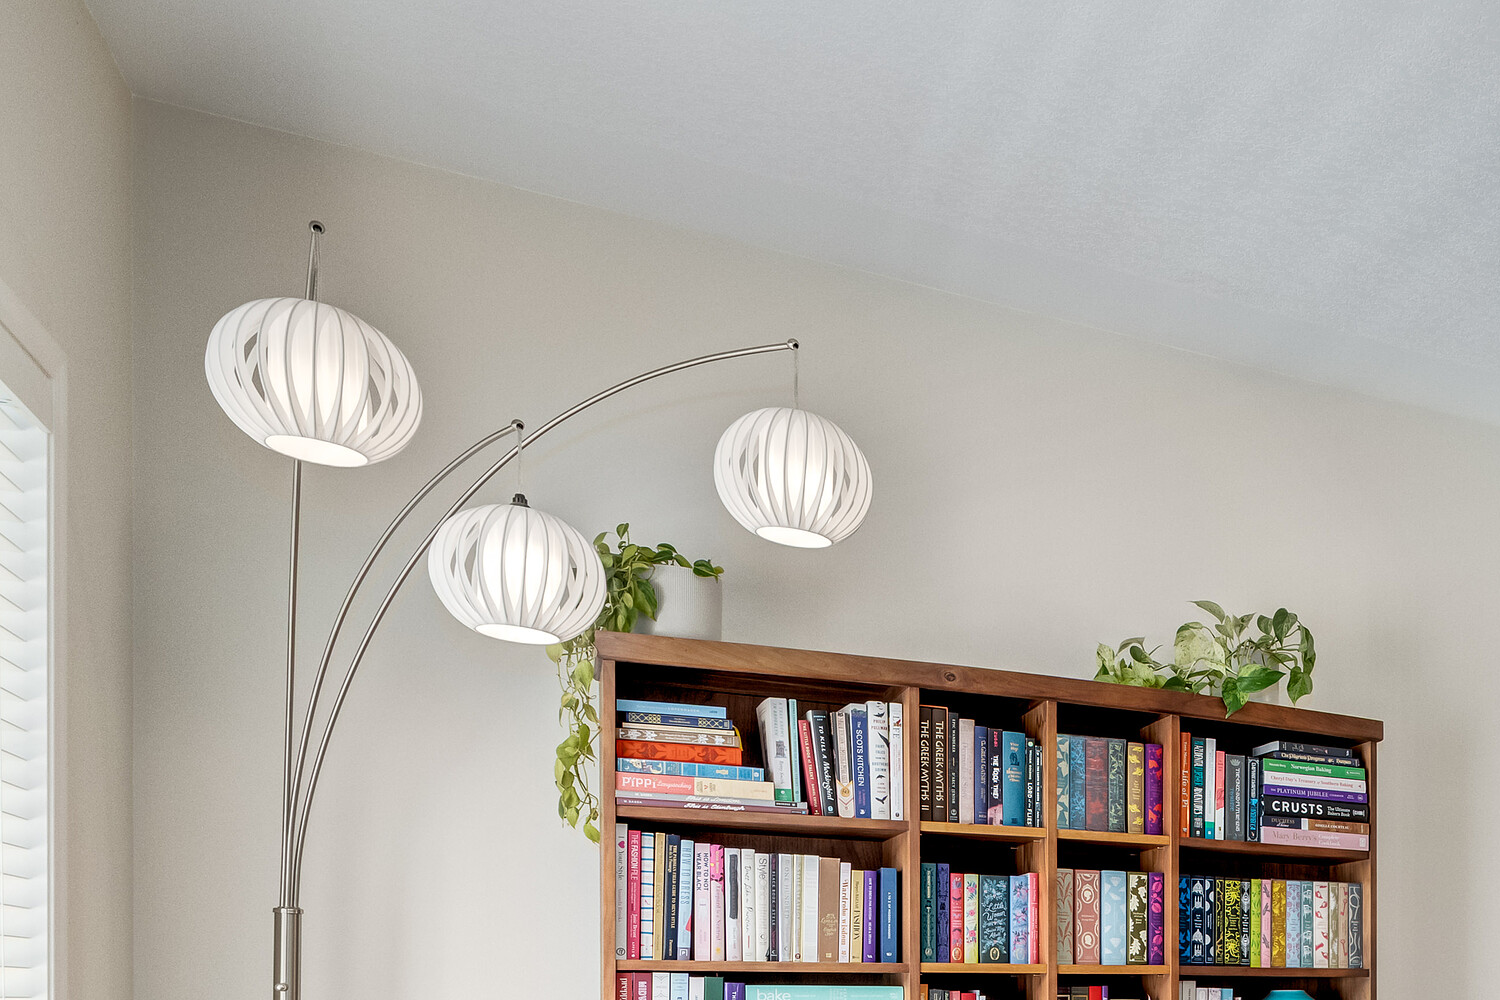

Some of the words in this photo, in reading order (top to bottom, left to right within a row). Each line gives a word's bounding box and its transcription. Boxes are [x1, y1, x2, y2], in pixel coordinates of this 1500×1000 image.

[921, 720, 929, 738] THE
[936, 721, 944, 739] THE
[856, 730, 864, 754] SCOTS
[921, 740, 929, 767] GREEK
[936, 740, 944, 768] GREEK
[857, 755, 865, 787] KITCHEN
[921, 768, 929, 801] MYTHS
[936, 769, 944, 801] MYTHS
[1182, 800, 1188, 808] Pi
[1272, 800, 1323, 815] CRUSTS
[630, 845, 639, 869] FASHION
[758, 858, 768, 879] Style
[631, 870, 639, 880] FILE
